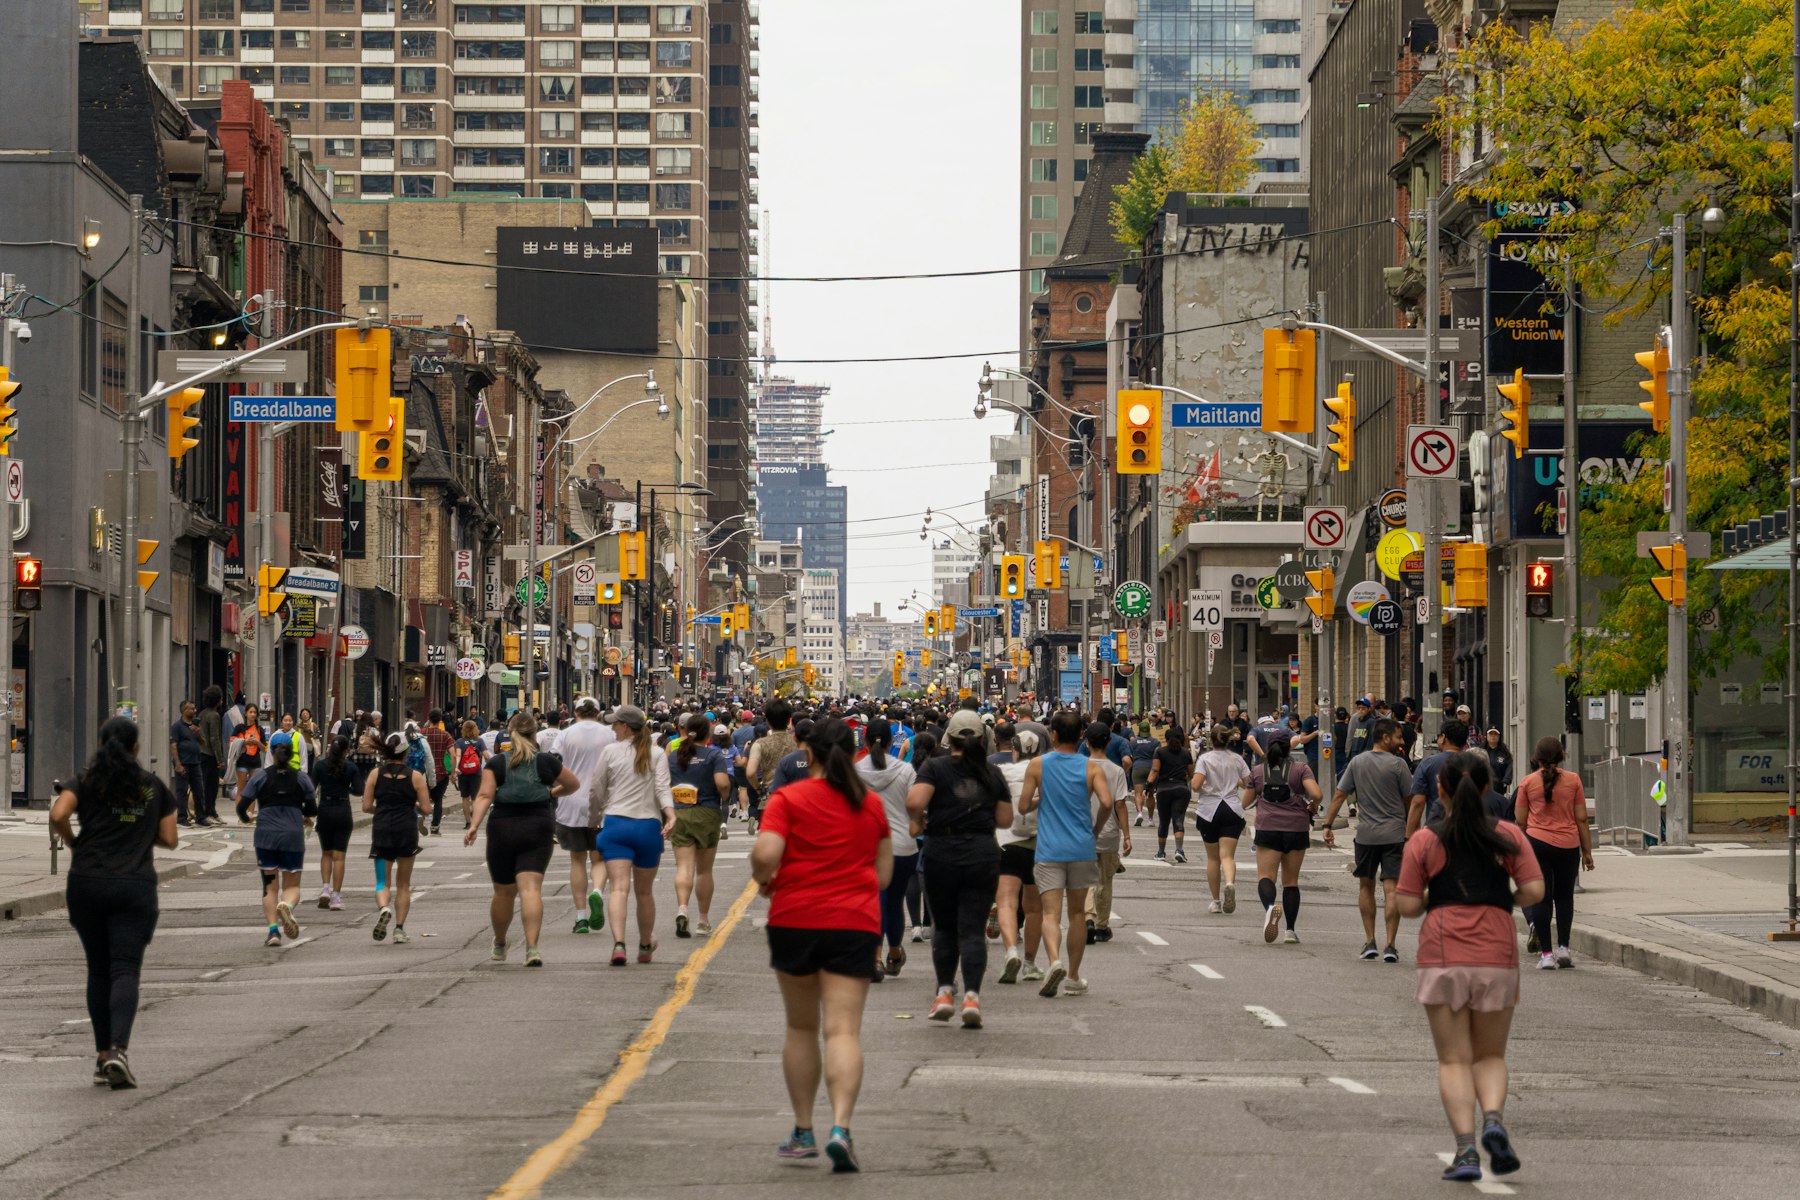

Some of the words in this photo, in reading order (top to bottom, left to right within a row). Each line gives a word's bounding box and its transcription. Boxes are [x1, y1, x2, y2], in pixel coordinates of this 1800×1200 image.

[1495, 317, 1548, 328] Western
[1512, 329, 1548, 341] Union
[233, 401, 332, 418] Breadalbane
[1186, 407, 1261, 424] Maitland
[760, 466, 798, 474] FITZROVIA
[457, 550, 470, 580] SPA
[1305, 554, 1340, 567] LCO
[287, 577, 329, 589] Breadalbane
[330, 582, 337, 590] St
[486, 556, 496, 610] ELIOTS
[1117, 582, 1149, 598] MUNICIPAL
[1117, 602, 1151, 618] PARKING
[1192, 607, 1220, 625] 40
[457, 661, 475, 672] SPA
[685, 674, 690, 683] 1
[991, 675, 996, 683] 1
[1739, 755, 1773, 768] FOR
[1761, 774, 1785, 785] sq.ft
